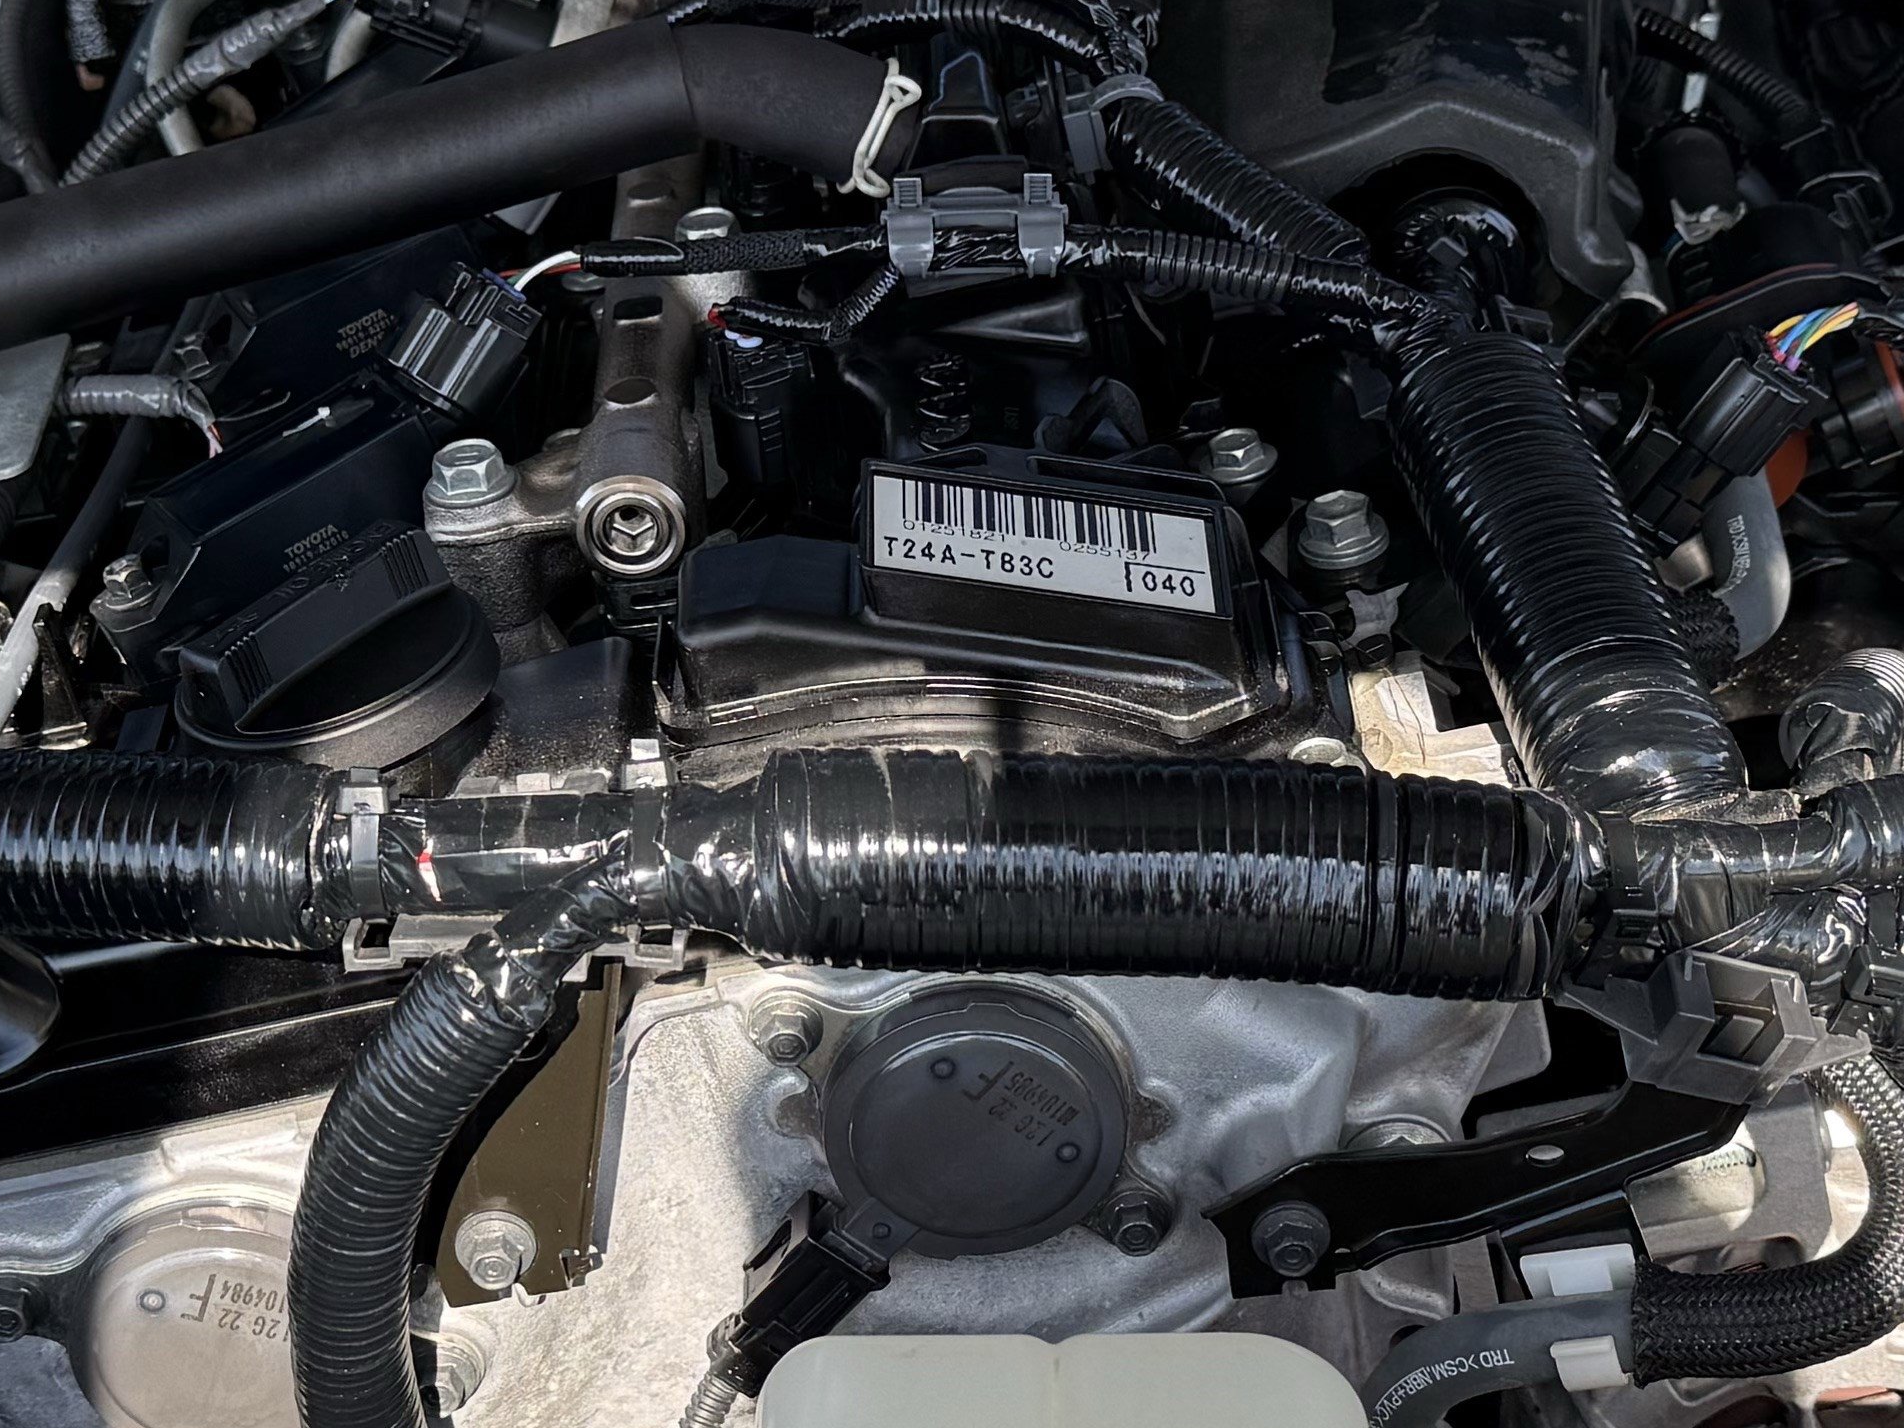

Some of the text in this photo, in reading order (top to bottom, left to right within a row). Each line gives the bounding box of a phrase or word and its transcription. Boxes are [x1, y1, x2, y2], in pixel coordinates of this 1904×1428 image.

[336, 307, 388, 338] TOYOTA
[283, 524, 338, 558] TOYOTA
[1141, 571, 1196, 597] 040
[962, 1060, 1014, 1102] F
[179, 1271, 217, 1323] F
[1478, 1347, 1516, 1368] TRD
